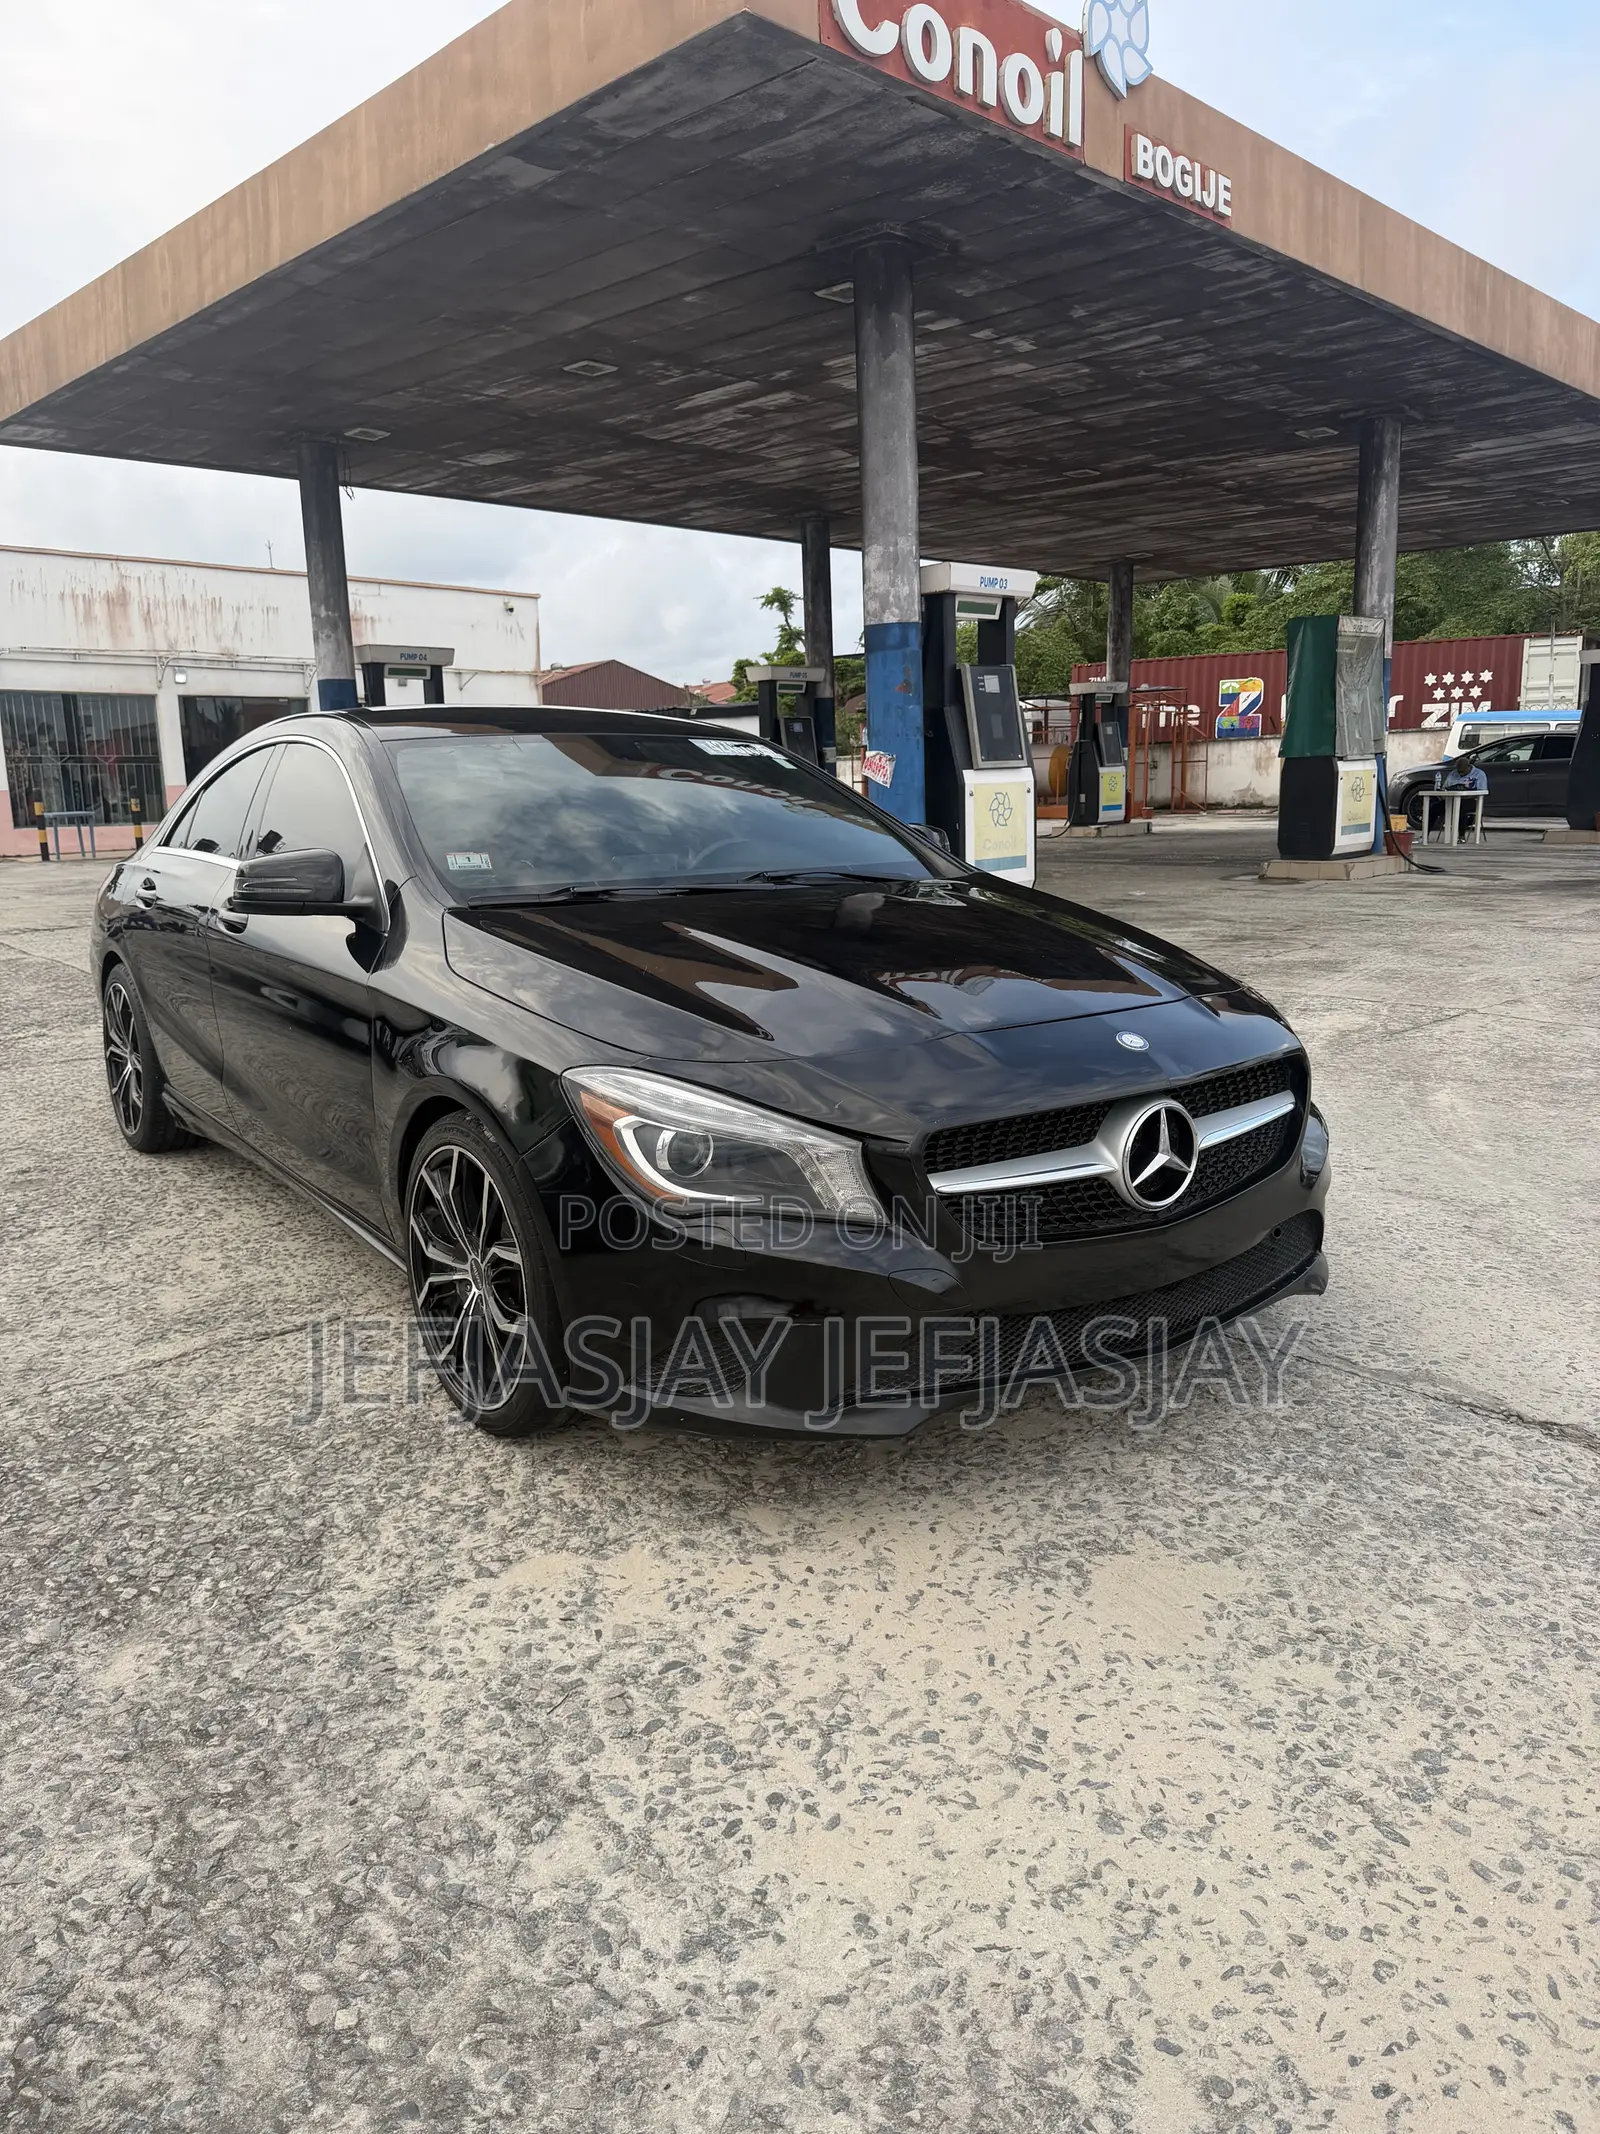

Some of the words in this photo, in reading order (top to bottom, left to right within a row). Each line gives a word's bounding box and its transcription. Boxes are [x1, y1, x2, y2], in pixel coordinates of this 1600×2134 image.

[833, 0, 1083, 147] Conoil
[1135, 134, 1232, 217] BOGIJE
[980, 576, 998, 588] PUMP
[999, 578, 1008, 589] 03
[400, 653, 417, 661] PUMP
[418, 653, 428, 661] 04
